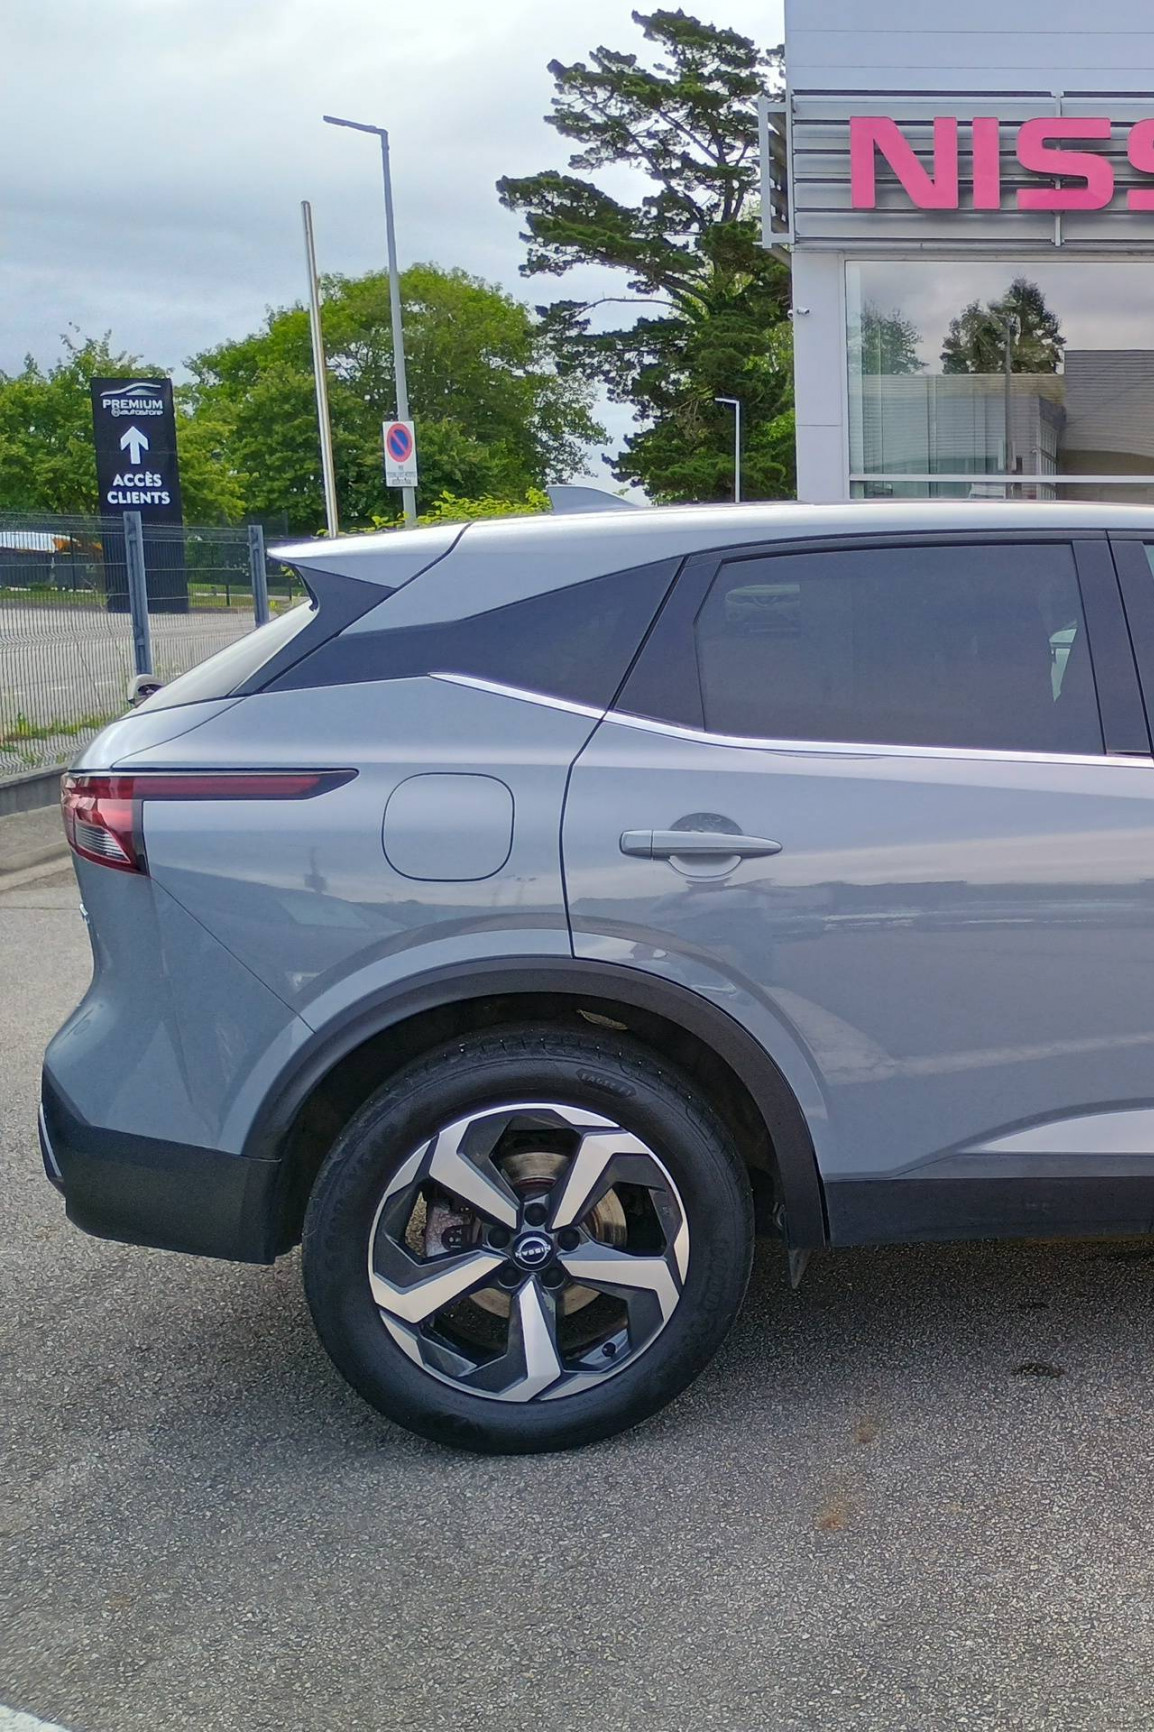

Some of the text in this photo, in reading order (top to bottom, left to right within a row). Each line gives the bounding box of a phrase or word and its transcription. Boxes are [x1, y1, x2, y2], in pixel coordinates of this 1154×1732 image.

[103, 399, 163, 410] PREMIUM
[113, 471, 162, 487] ACCÈS
[107, 490, 171, 504] CLIENTS
